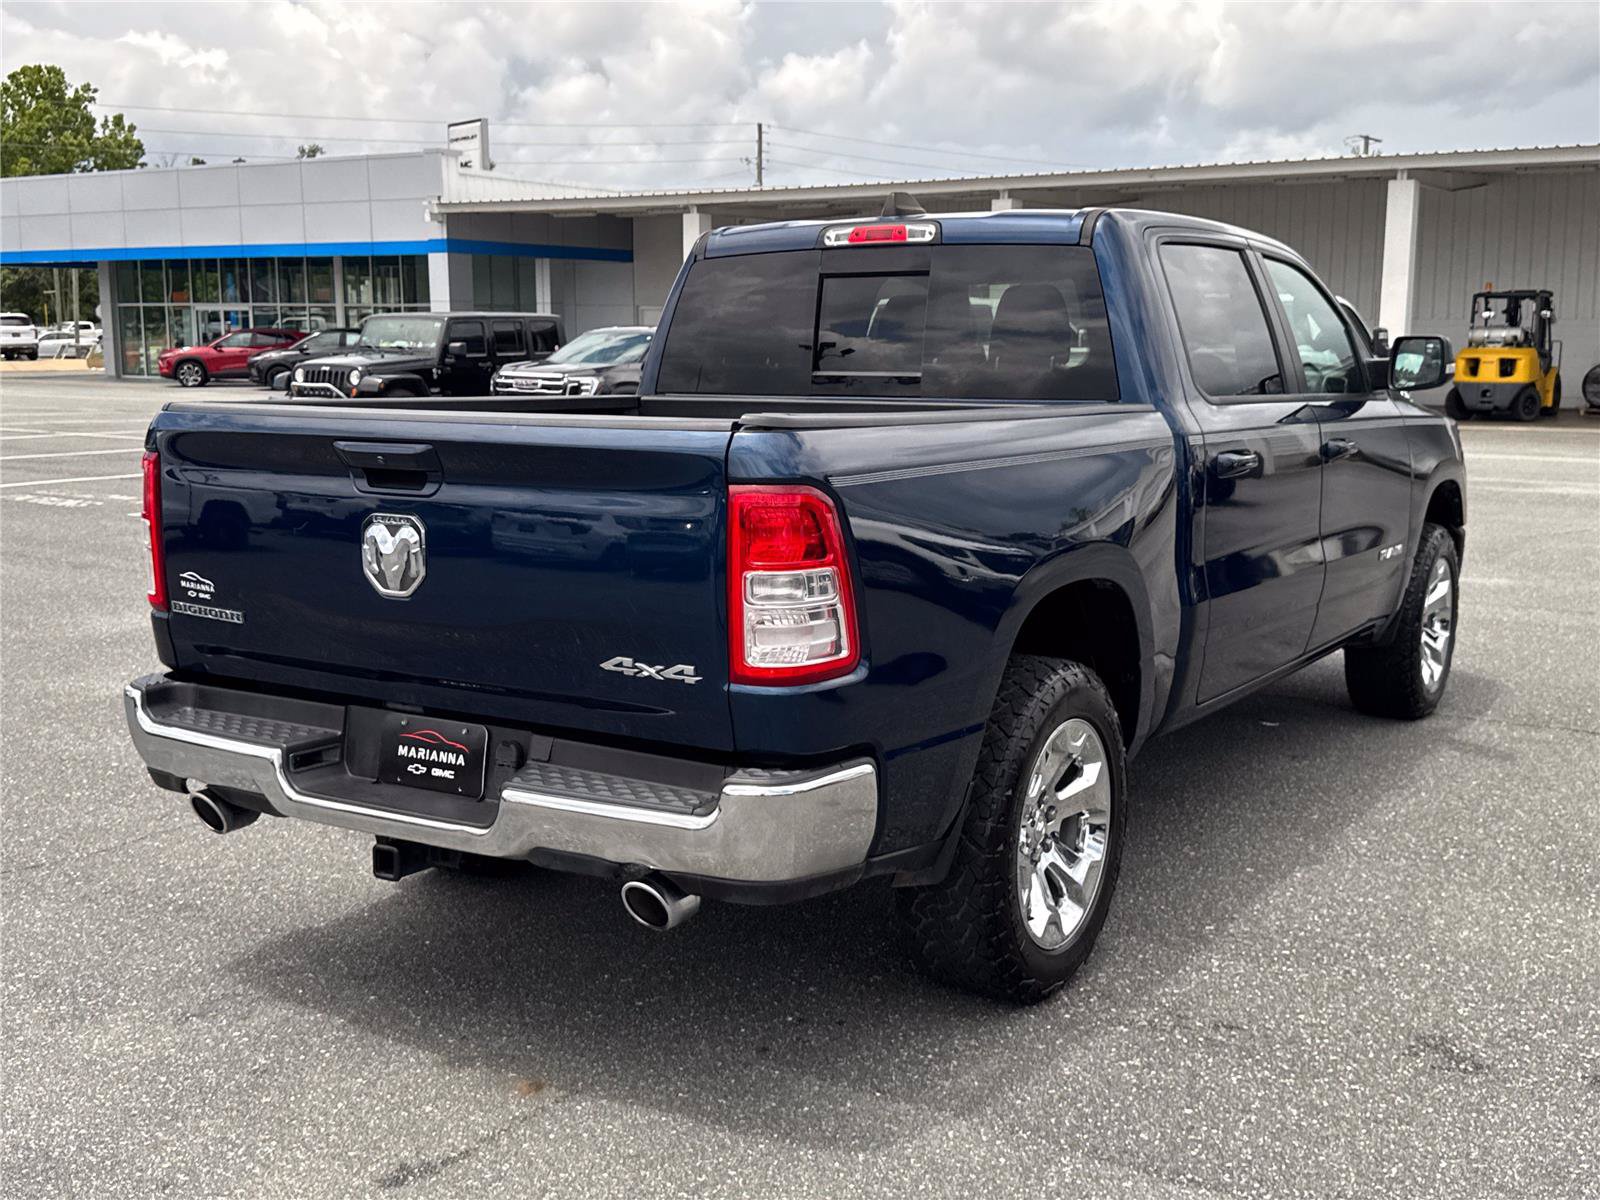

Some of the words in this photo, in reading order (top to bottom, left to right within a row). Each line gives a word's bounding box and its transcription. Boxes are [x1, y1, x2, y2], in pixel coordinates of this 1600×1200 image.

[460, 160, 472, 168] MC
[180, 580, 215, 592] MARIANNA
[397, 744, 465, 767] MARIANNA
[431, 767, 455, 779] GMC
